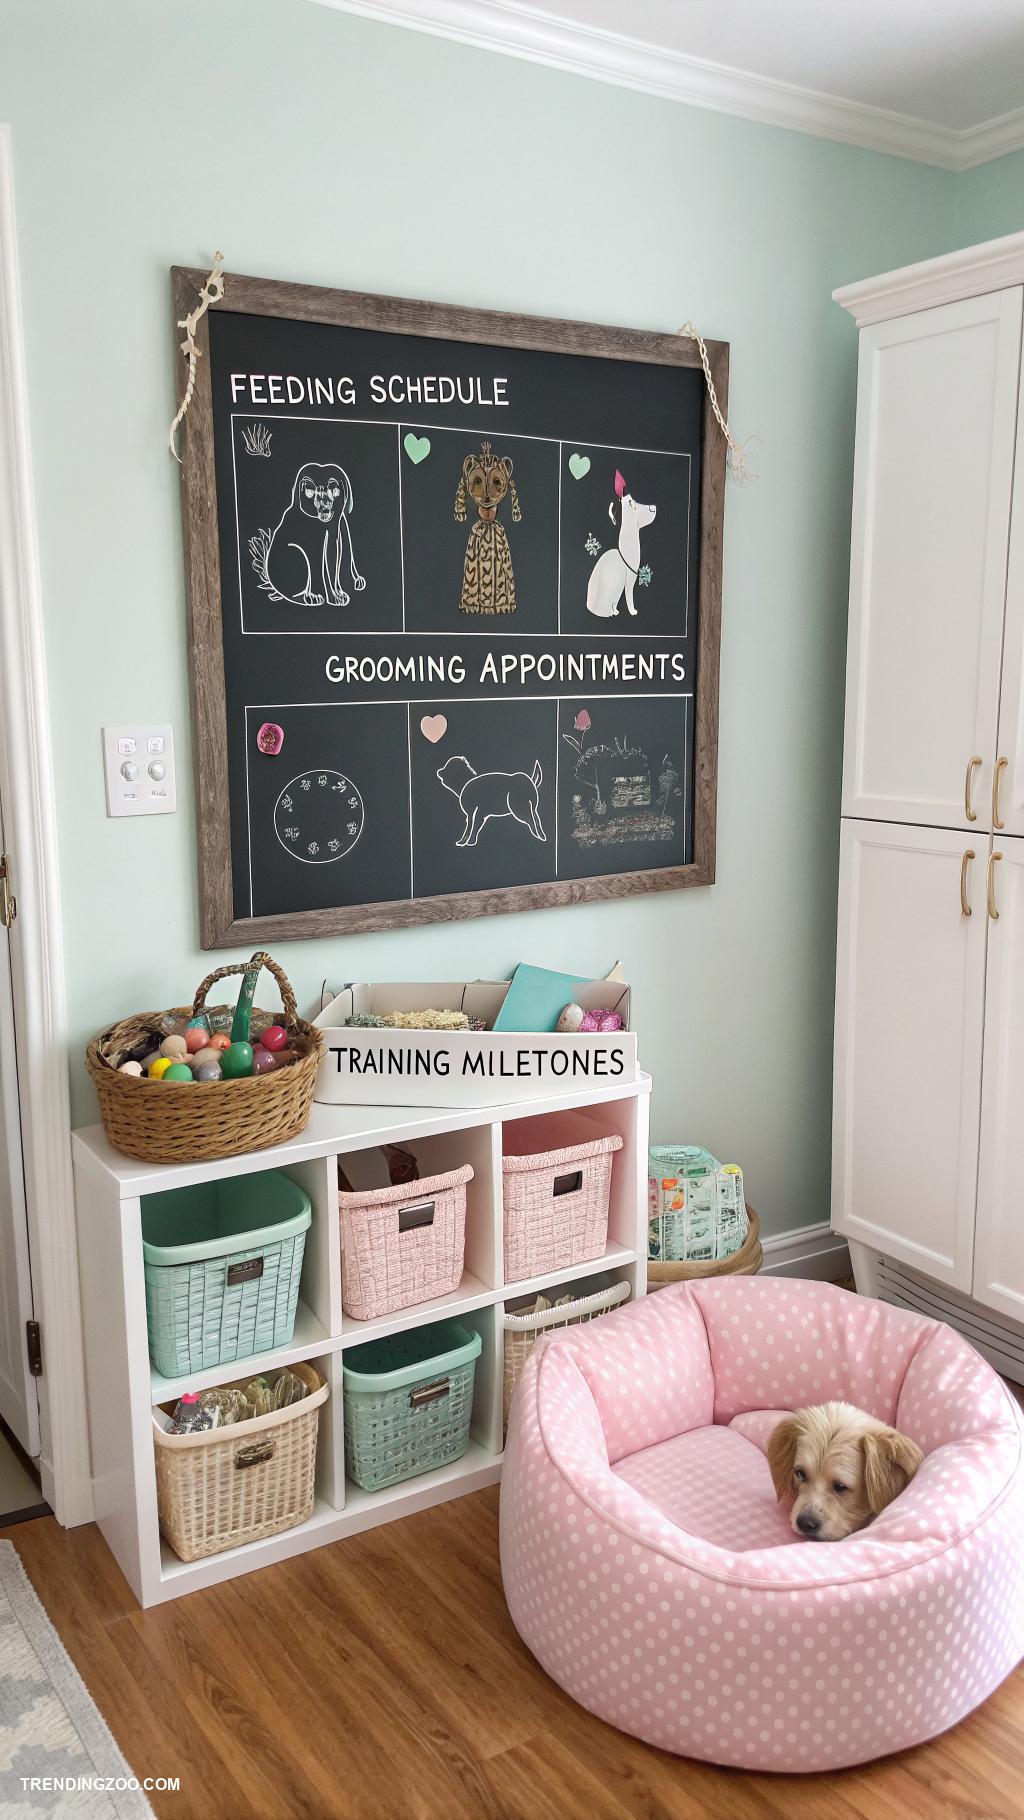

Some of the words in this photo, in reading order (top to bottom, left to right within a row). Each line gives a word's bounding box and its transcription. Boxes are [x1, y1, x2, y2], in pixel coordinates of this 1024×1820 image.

[230, 374, 356, 405] FEEDING
[370, 375, 510, 406] SCHEDULE
[325, 654, 466, 684] GROOMING
[479, 652, 686, 684] APPOINTMENTS
[329, 1047, 450, 1076] TRAINING
[461, 1048, 624, 1077] MILETONES
